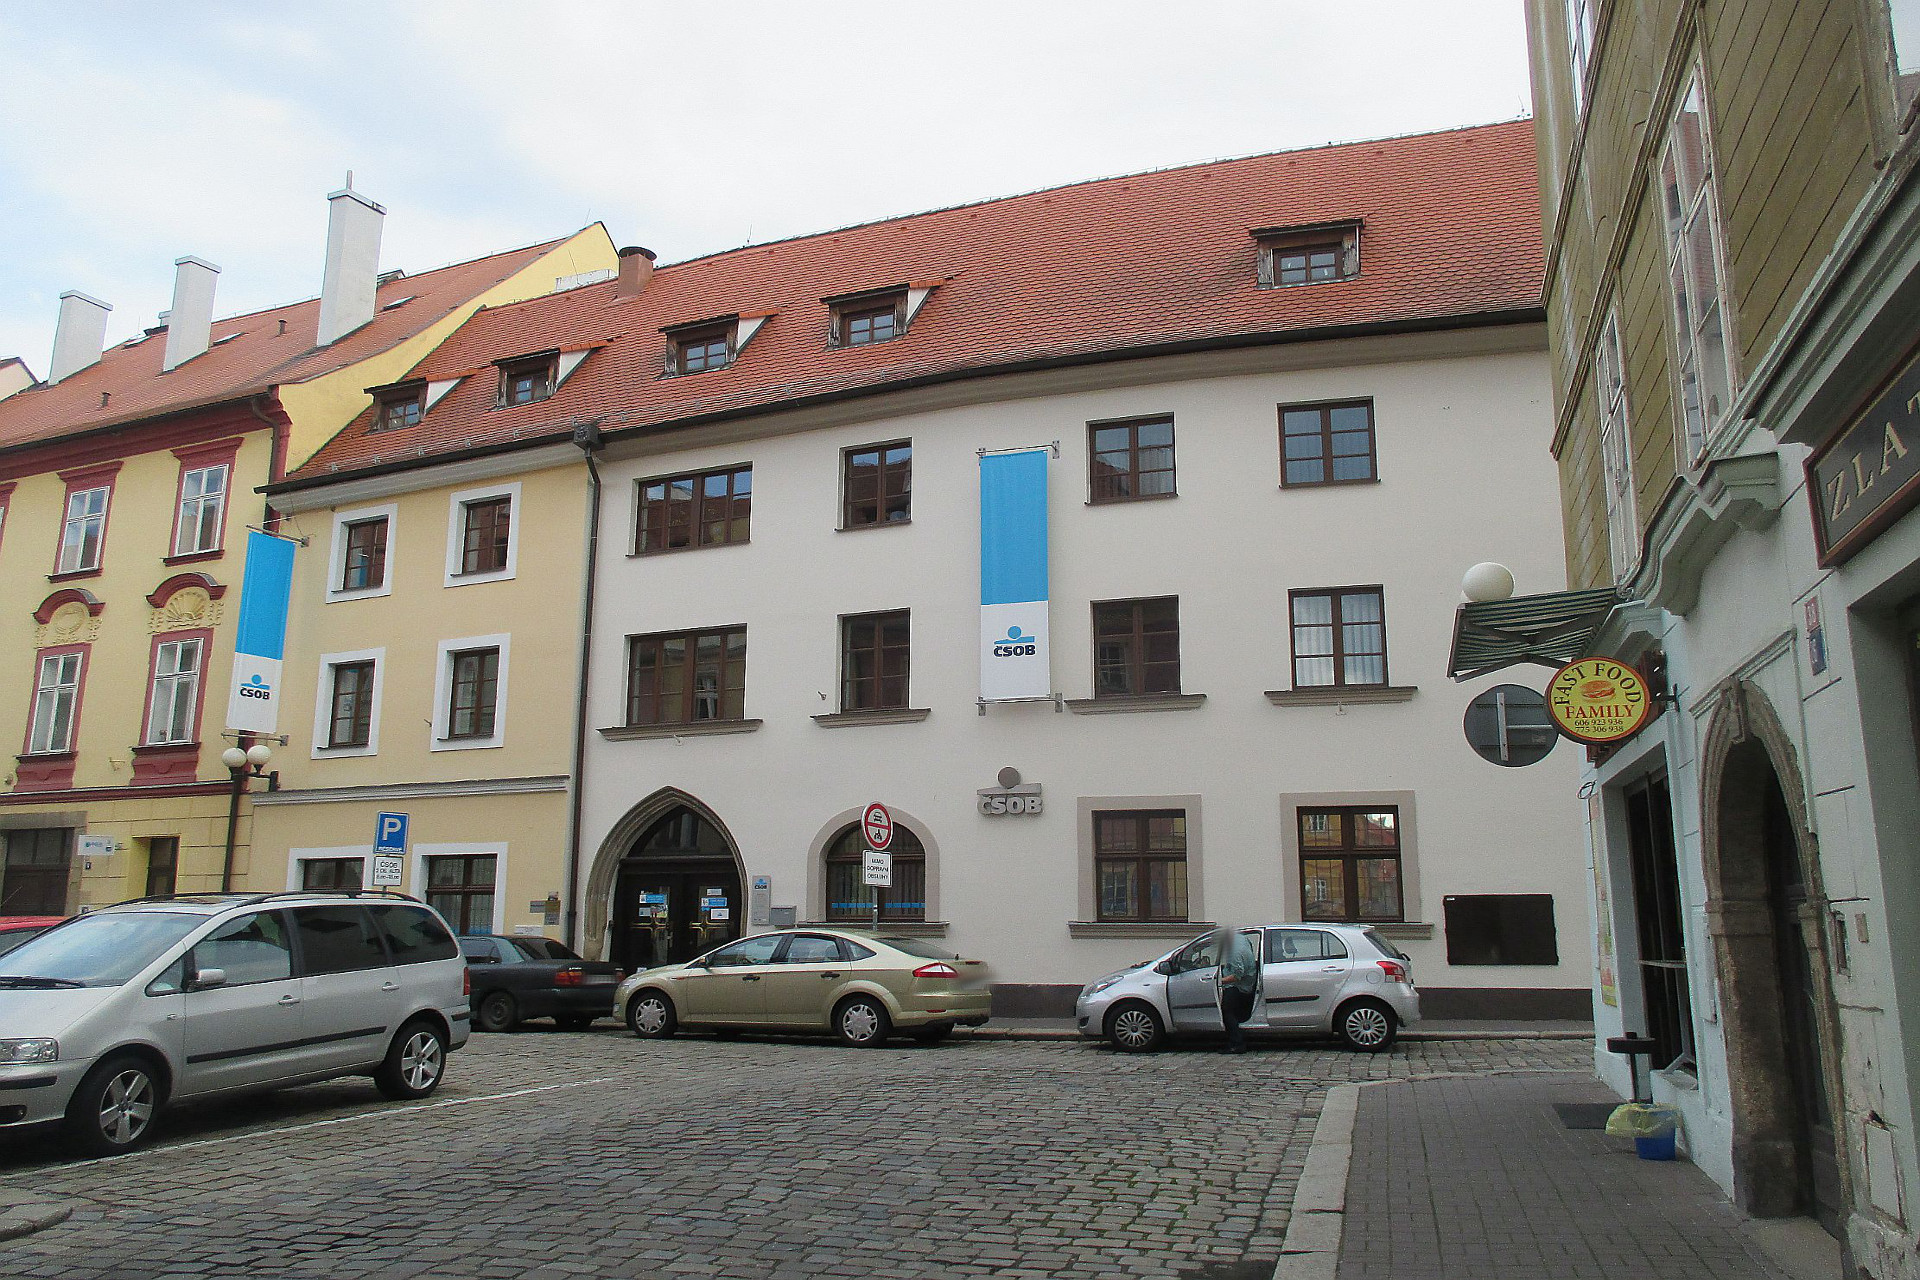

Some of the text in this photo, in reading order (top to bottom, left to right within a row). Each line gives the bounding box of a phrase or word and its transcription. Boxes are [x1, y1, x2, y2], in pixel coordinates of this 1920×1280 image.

[993, 644, 1036, 658] ČSOB
[240, 687, 270, 700] ČSOB
[1553, 663, 1642, 706] FAST FOOD
[1565, 704, 1635, 719] FAMILY
[976, 795, 1043, 816] ČSOB
[382, 817, 402, 841] P
